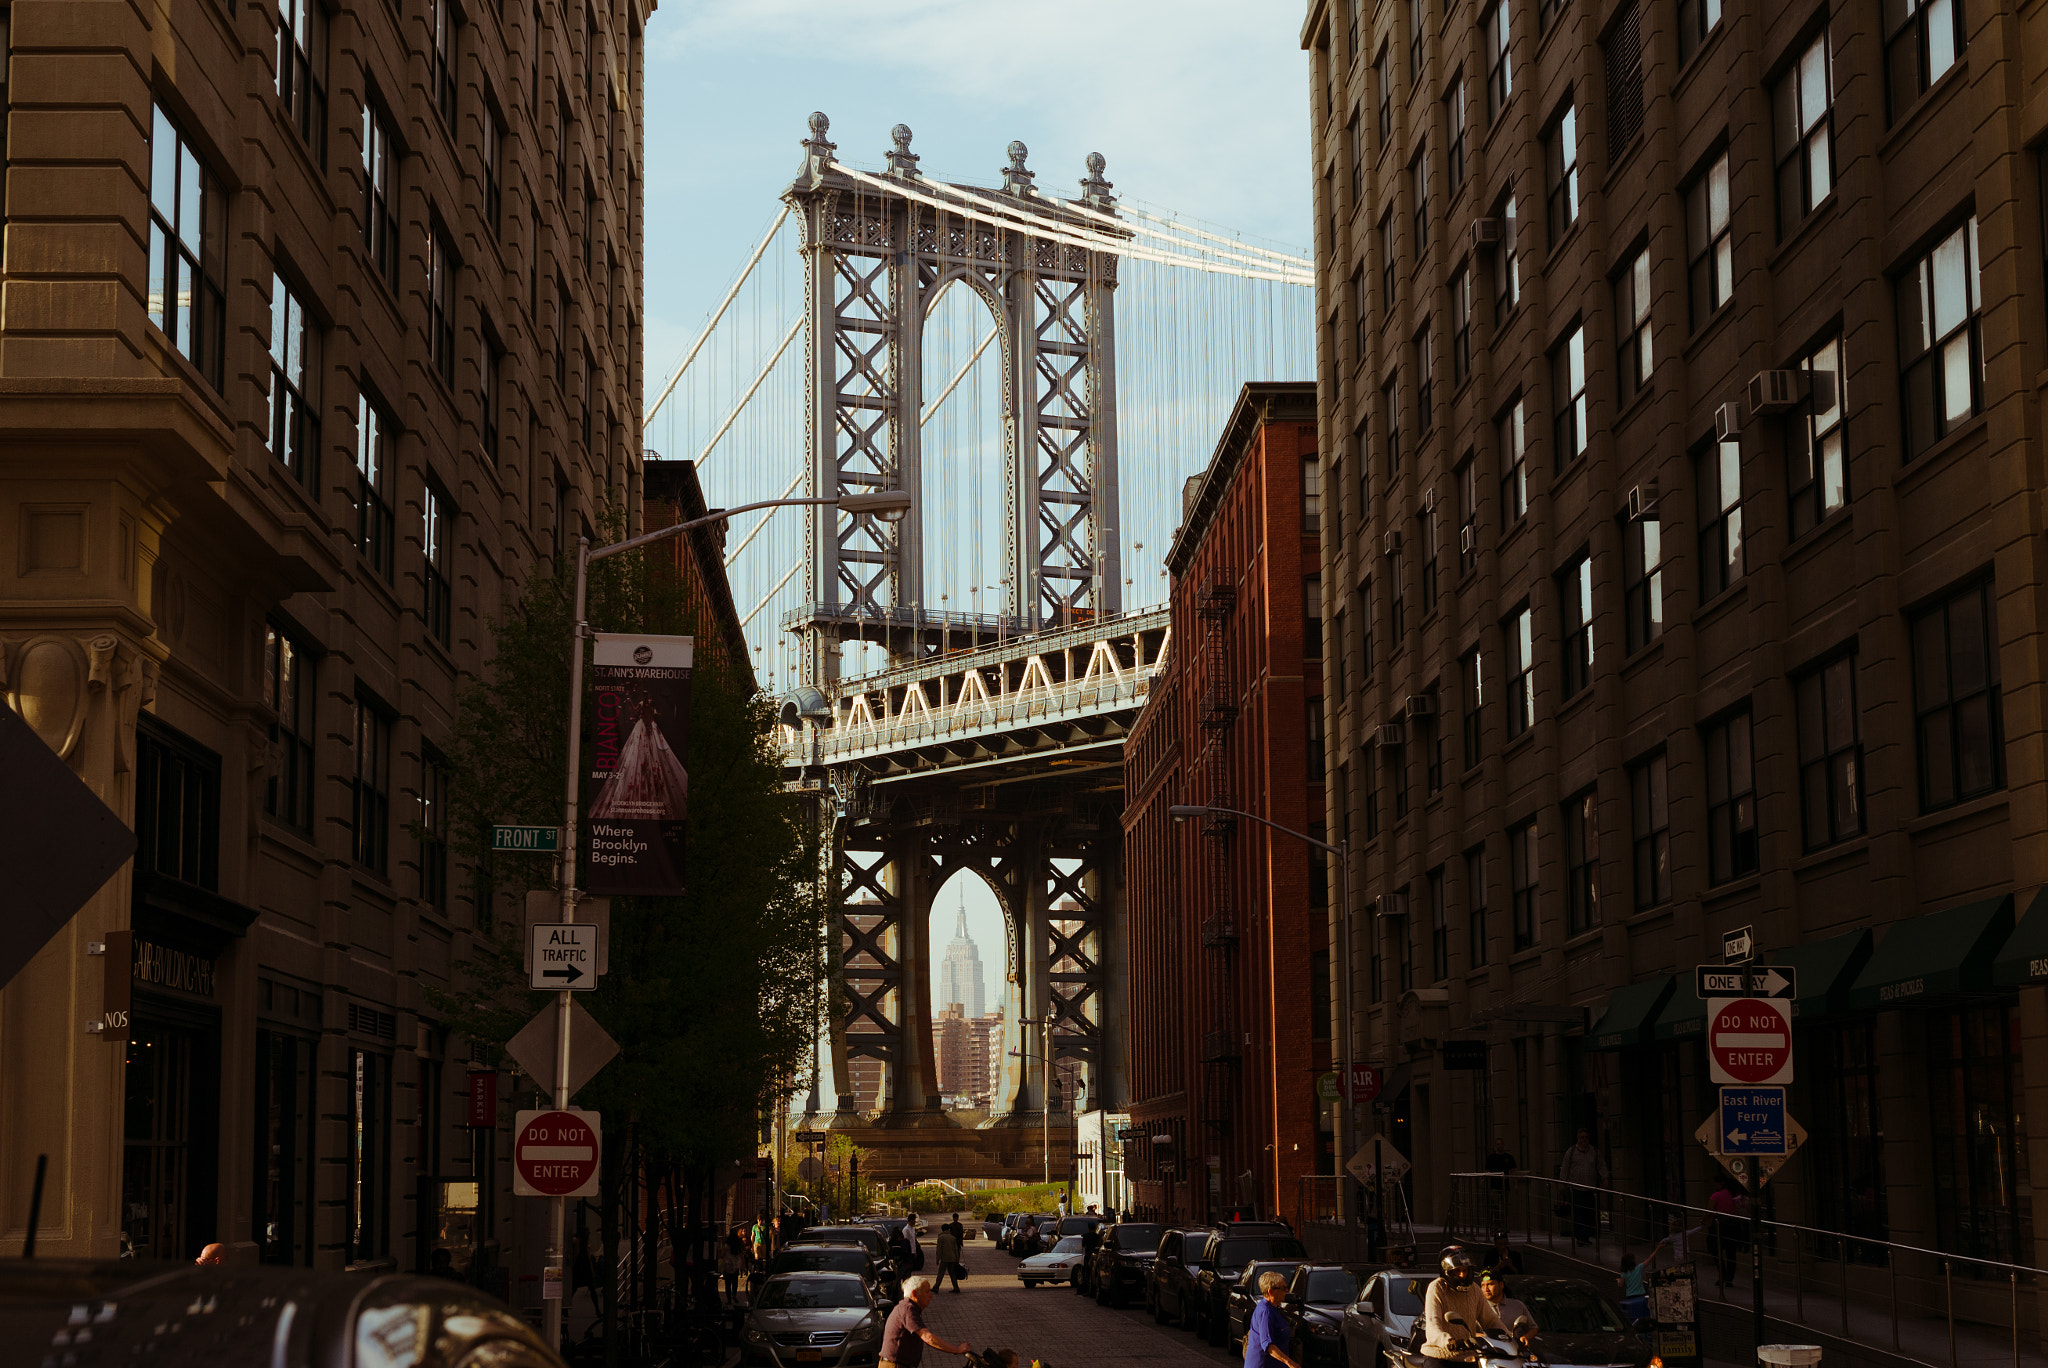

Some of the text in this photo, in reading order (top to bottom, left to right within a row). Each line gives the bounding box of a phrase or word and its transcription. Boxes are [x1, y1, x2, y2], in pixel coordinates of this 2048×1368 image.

[594, 667, 691, 680] ST. ANN'S WAREHOUSE
[596, 692, 620, 769] BIANCO
[592, 771, 608, 779] MAY
[592, 825, 634, 836] Where
[495, 828, 556, 848] FRONT ST
[592, 838, 648, 853] Brooklyn
[592, 852, 638, 866] Begins.
[549, 930, 580, 945] ALL
[1727, 941, 1735, 955] ONE
[542, 949, 587, 962] TRAFFIC
[1709, 976, 1735, 989] ONE
[104, 1011, 128, 1028] NOS
[1721, 1016, 1777, 1029] DO NOT
[1728, 1053, 1774, 1066] ENTER
[476, 1078, 484, 1121] MARKET
[1723, 1096, 1781, 1106] East River
[1737, 1112, 1768, 1124] Ferry
[529, 1128, 586, 1141] DO NOT
[533, 1165, 579, 1179] ENTER
